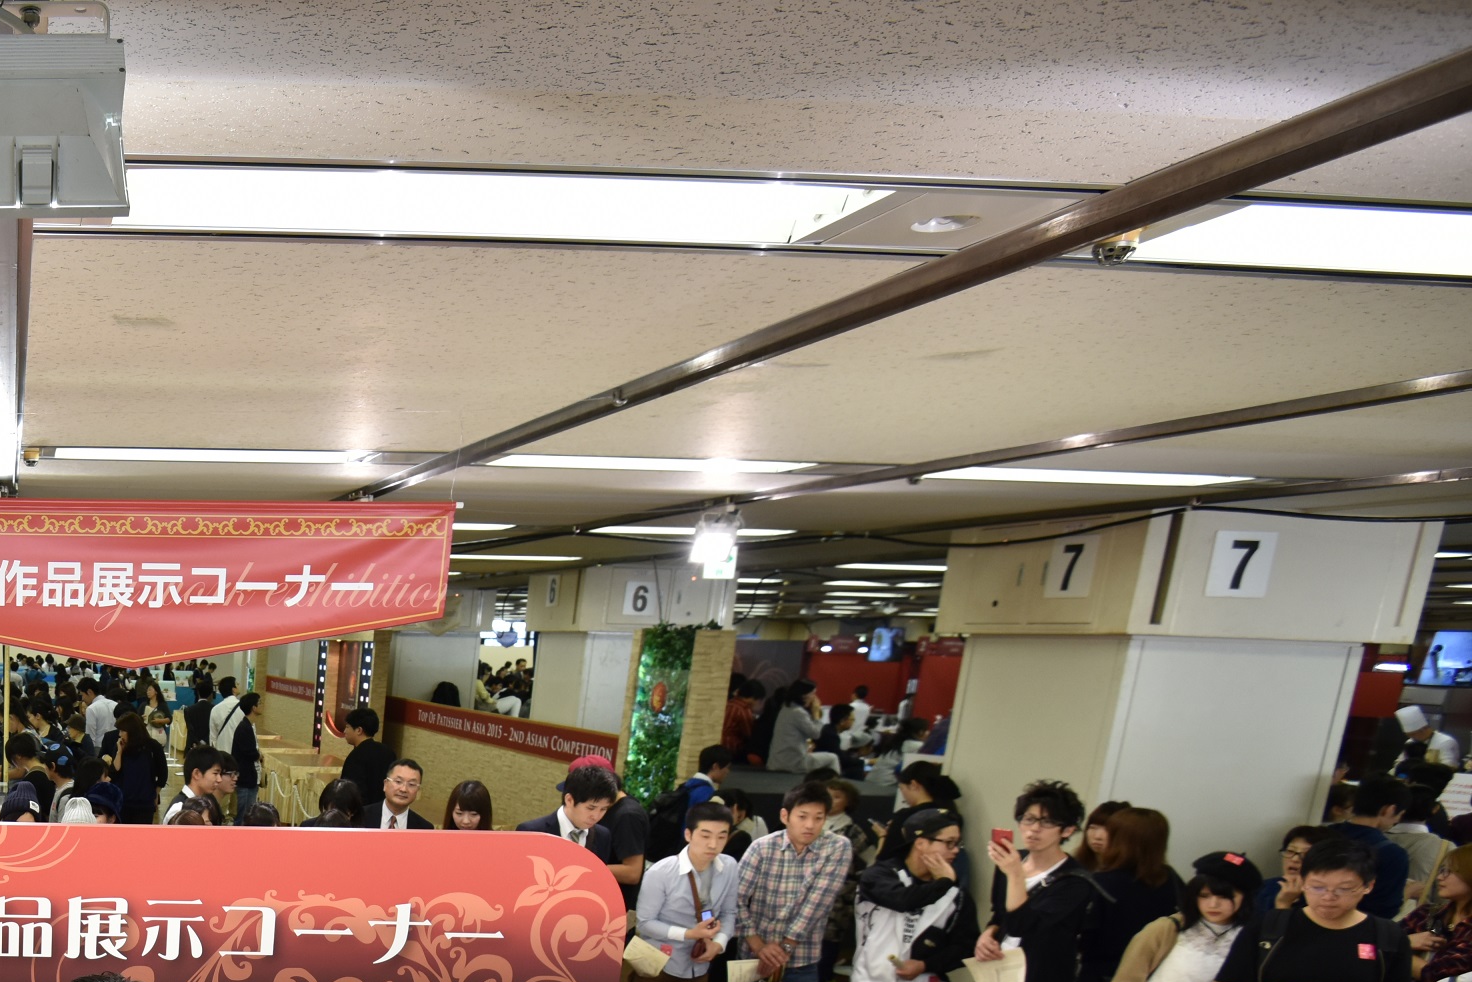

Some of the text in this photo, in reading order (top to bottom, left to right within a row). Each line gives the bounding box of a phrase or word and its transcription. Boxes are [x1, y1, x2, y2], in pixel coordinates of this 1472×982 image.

[1060, 544, 1085, 591] 7
[1229, 540, 1261, 590] 7
[549, 578, 557, 604] 6
[632, 585, 649, 612] 6
[487, 722, 503, 739] 2015
